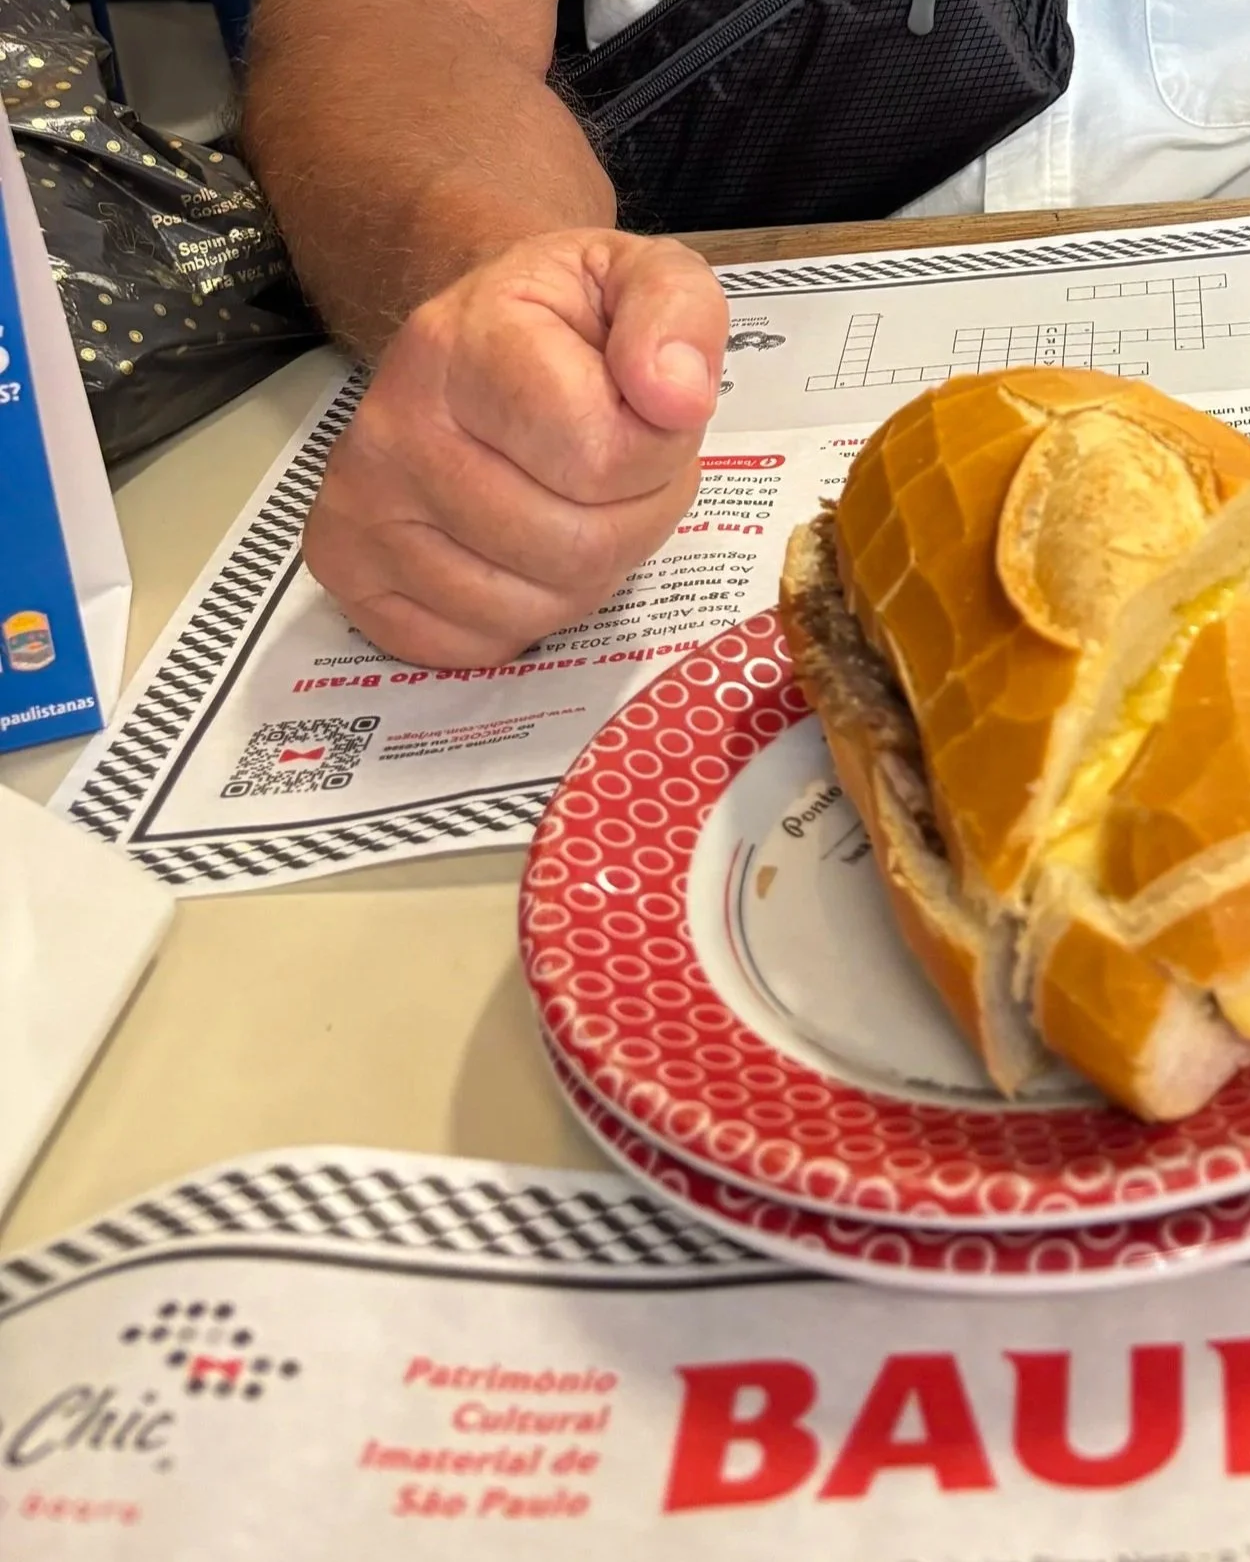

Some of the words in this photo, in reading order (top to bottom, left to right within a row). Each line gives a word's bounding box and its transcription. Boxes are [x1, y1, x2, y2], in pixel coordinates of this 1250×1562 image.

[699, 459, 757, 468] /barpont
[727, 475, 782, 485] cultura
[699, 487, 755, 496] 28/12/2
[758, 488, 778, 496] de
[697, 498, 774, 508] Imaterial
[703, 510, 750, 519] Bauru
[756, 511, 771, 519] O
[677, 521, 710, 535] pa
[717, 523, 764, 536] Um
[661, 550, 757, 565] degustando
[670, 564, 726, 576] provar
[729, 565, 754, 574] Ao
[625, 572, 654, 583] esp
[660, 578, 722, 590] mundo
[726, 577, 750, 586] do
[649, 593, 697, 607] lugar
[734, 590, 746, 598] o
[598, 600, 647, 616] entre
[647, 606, 694, 621] Atlas,
[698, 604, 741, 613] Taste
[594, 616, 641, 631] nosso
[710, 617, 737, 627] No
[641, 620, 705, 639] ranking
[570, 635, 612, 650] 2023
[616, 632, 638, 643] de
[546, 642, 567, 653] da
[592, 639, 700, 665] melhor
[292, 674, 382, 694] Brasil
[390, 670, 429, 686] do
[450, 726, 514, 744] QRCODE
[466, 731, 530, 749] Confirme
[383, 741, 429, 752] acesse
[430, 739, 449, 747] ou
[378, 747, 445, 762] respostas
[782, 786, 843, 838] Ponto
[402, 1355, 619, 1394] Patrimônio
[452, 1401, 612, 1433] Cultural
[3, 1382, 174, 1470] Chic
[359, 1439, 546, 1474] Imaterial
[550, 1446, 600, 1474] de
[392, 1484, 467, 1517] São
[478, 1486, 592, 1518] Paulo
